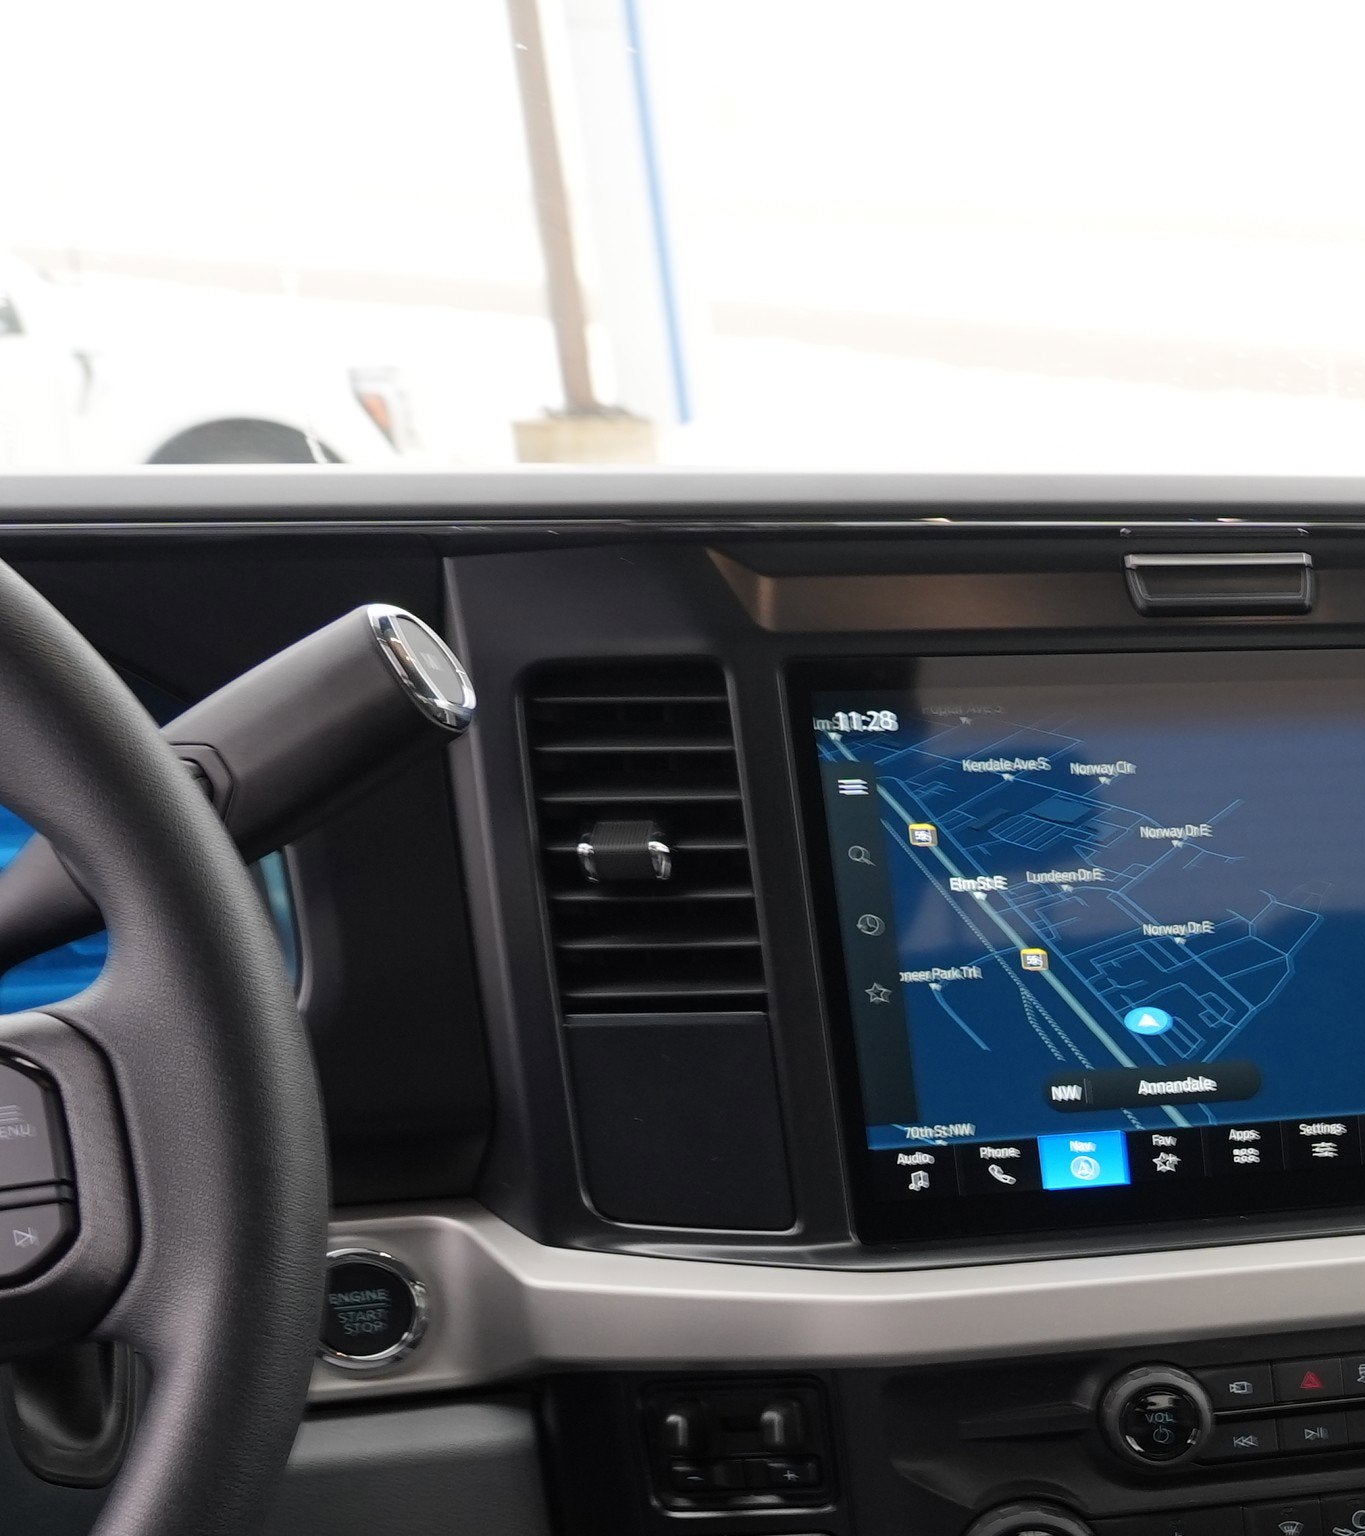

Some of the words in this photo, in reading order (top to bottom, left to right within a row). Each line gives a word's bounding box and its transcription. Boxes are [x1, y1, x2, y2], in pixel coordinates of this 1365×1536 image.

[835, 710, 899, 732] 11:28
[962, 758, 1014, 772] Kendale
[1014, 757, 1037, 770] Ave
[1070, 762, 1115, 776] Norway
[1140, 826, 1184, 839] Norway
[1185, 824, 1200, 837] Dr
[1200, 824, 1213, 837] E
[1026, 870, 1077, 883] Lundeen
[1078, 868, 1092, 881] Dr
[1092, 868, 1106, 881] E
[950, 877, 976, 892] Elm
[994, 875, 1008, 890] E
[1142, 923, 1186, 936] Norway
[1187, 921, 1202, 934] Dr
[1202, 921, 1215, 934] E
[932, 967, 964, 981] Park
[1051, 1084, 1083, 1101] NW
[1138, 1076, 1217, 1096] Annandale
[0, 1123, 31, 1139] ENU
[905, 1126, 933, 1139] 70th
[949, 1123, 976, 1136] NW
[1229, 1129, 1261, 1141] Apps
[1299, 1122, 1347, 1136] Settings
[1070, 1140, 1097, 1153] Nav
[1152, 1134, 1177, 1146] Fav
[897, 1152, 935, 1165] Audio
[980, 1146, 1021, 1159] Phone
[328, 1289, 389, 1305] ENGINE
[338, 1309, 385, 1323] START
[344, 1321, 387, 1335] STOP
[1145, 1411, 1175, 1423] VOL
